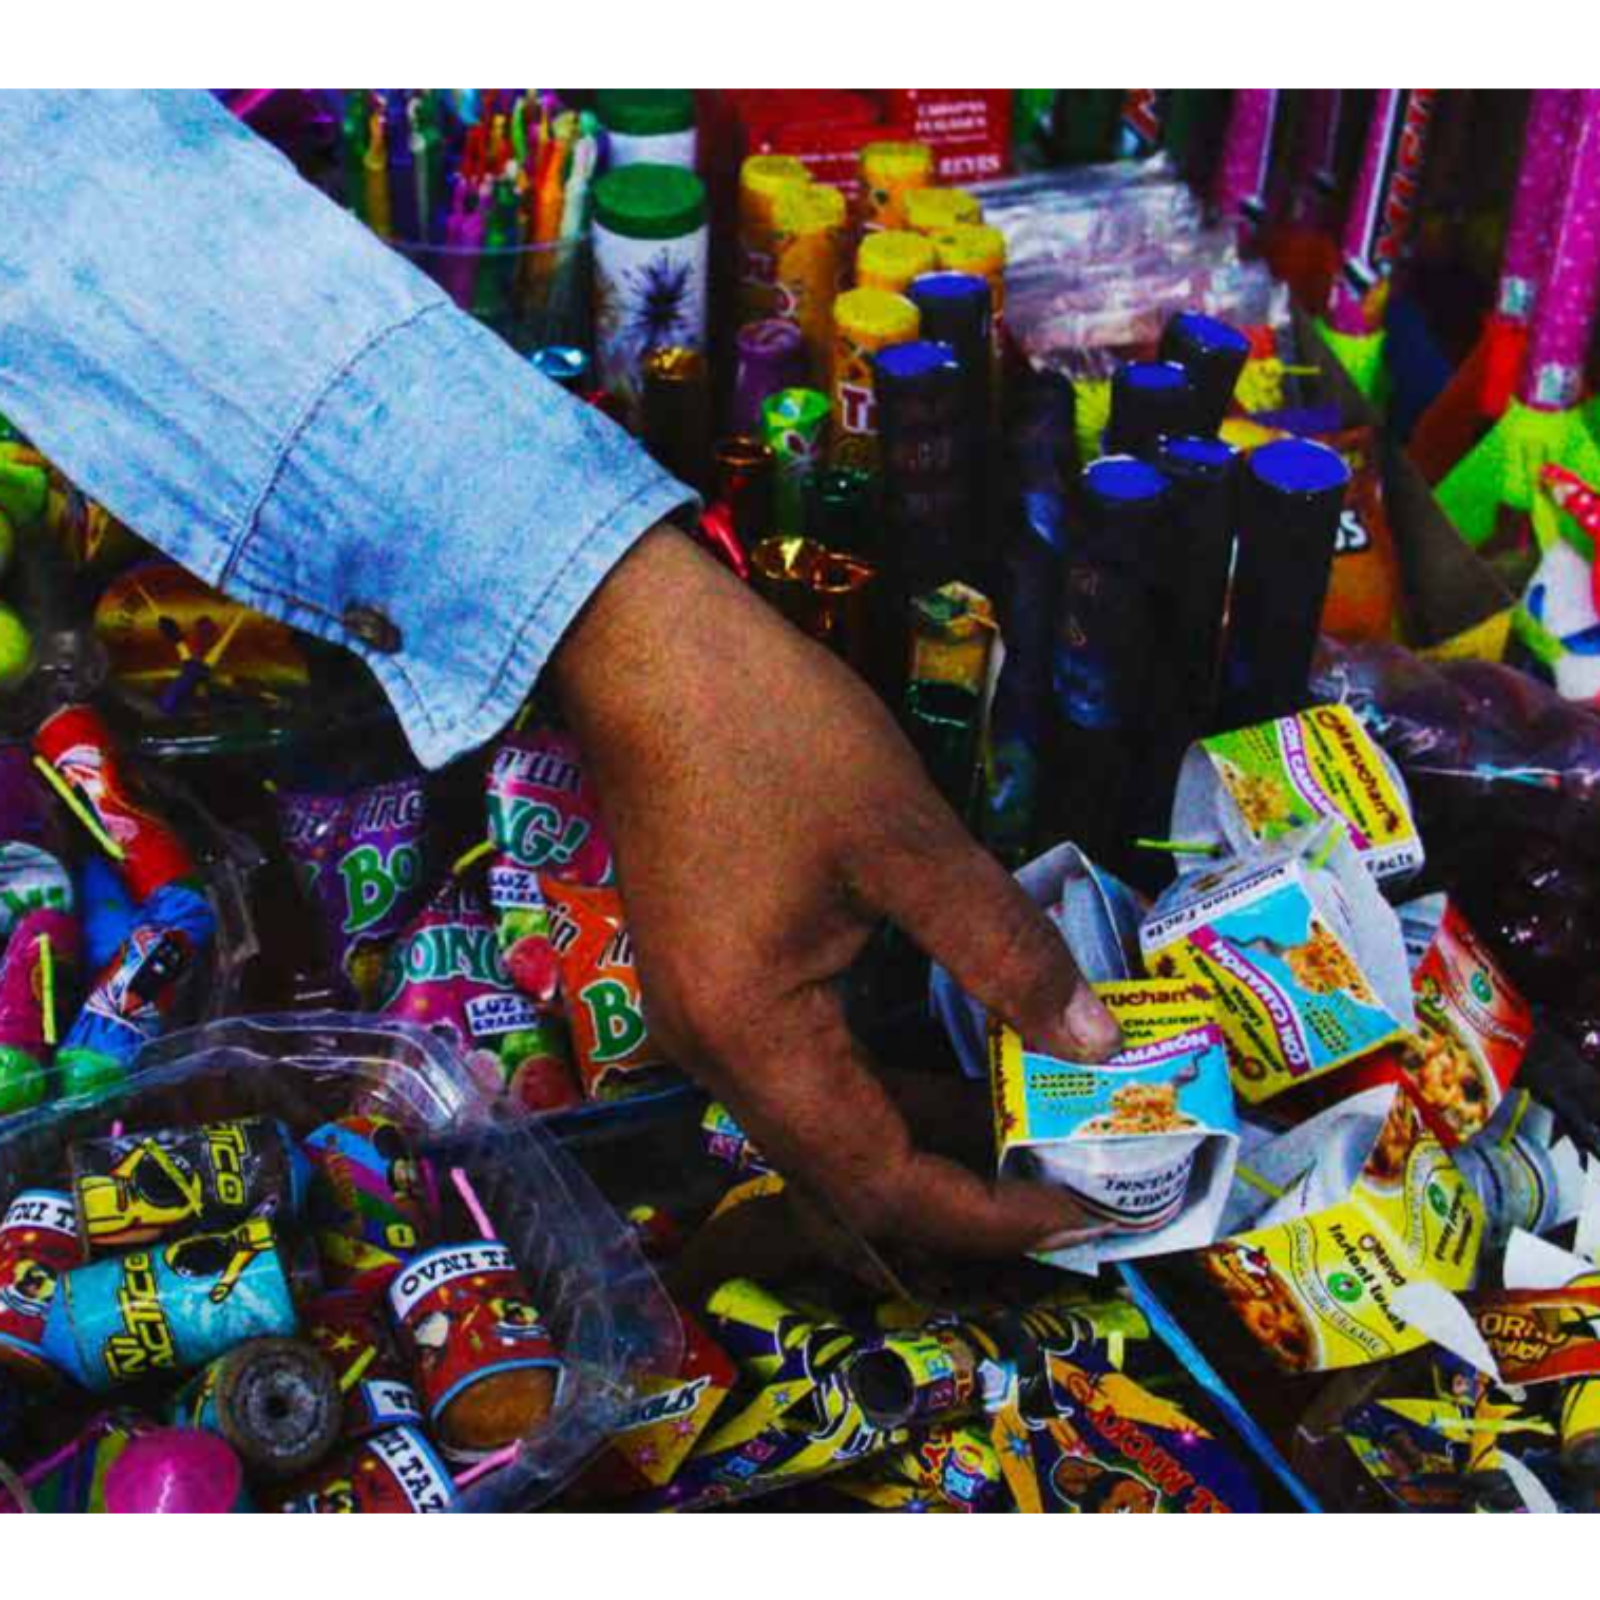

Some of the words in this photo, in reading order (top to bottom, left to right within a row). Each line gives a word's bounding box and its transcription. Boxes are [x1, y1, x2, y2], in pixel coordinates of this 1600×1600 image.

[472, 997, 516, 1017] LUZ
[1101, 984, 1190, 1006] ruchan
[1109, 1031, 1210, 1065] AMARÓN
[400, 1250, 477, 1298] OVNI
